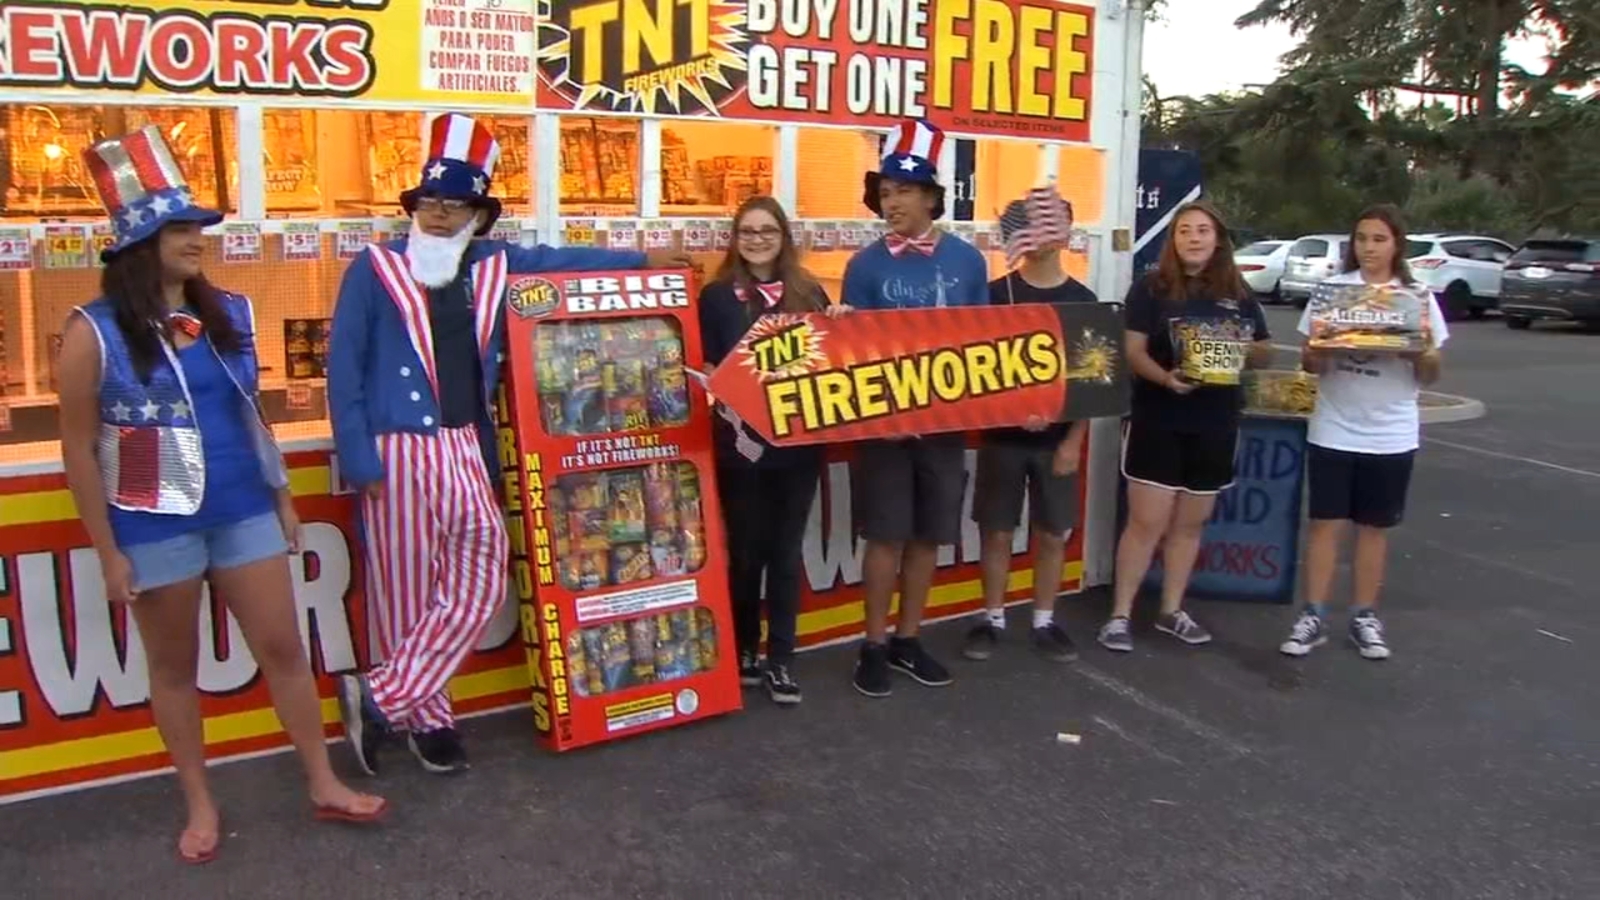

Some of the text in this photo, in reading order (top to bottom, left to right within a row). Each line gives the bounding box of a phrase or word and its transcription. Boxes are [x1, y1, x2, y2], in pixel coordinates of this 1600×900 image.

[849, 0, 927, 49] ONE
[440, 31, 515, 52] PARA PODER
[571, 0, 709, 85] TNT
[430, 51, 530, 73] COMPAR FUEGOS
[934, 0, 1088, 120] FREE
[624, 57, 719, 95] FIREWORKS
[748, 44, 927, 117] GET ONE
[973, 118, 1030, 131] SELECTED
[520, 285, 548, 307] TNT
[580, 273, 687, 294] BIG
[567, 290, 689, 313] BANG
[1331, 307, 1406, 325] ALLEGIANCE
[754, 323, 810, 371] TNT
[766, 332, 1061, 436] FIREWORKS
[577, 441, 587, 453] IF
[615, 436, 637, 449] NOT
[639, 434, 660, 446] TNT
[586, 452, 610, 465] NOT
[524, 453, 556, 585] MAXIMUM
[543, 602, 571, 716] CHARGE
